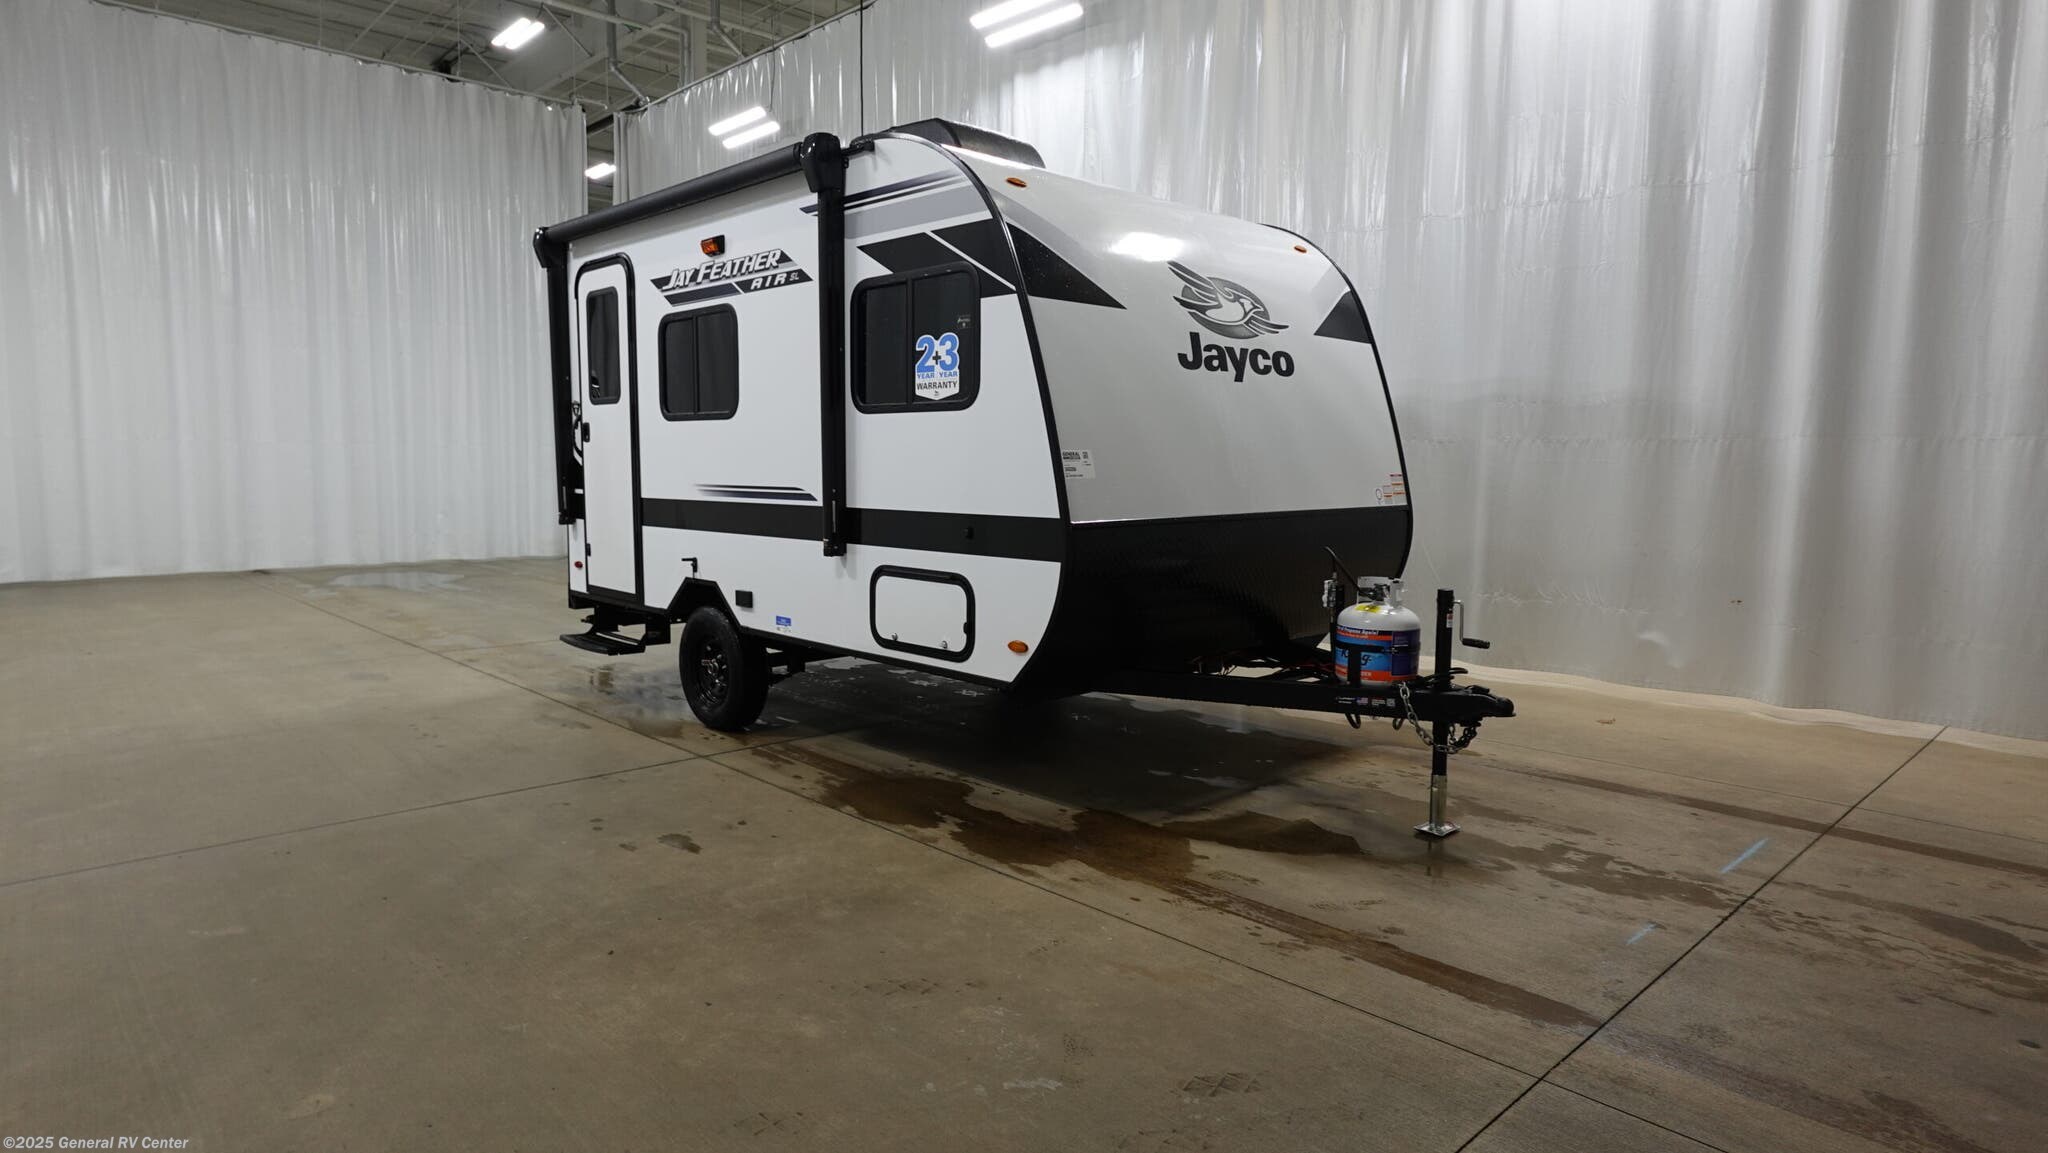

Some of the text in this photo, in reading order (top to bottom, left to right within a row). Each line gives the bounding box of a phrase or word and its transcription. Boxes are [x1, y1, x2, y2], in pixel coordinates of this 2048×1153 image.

[662, 249, 782, 291] JAY FEATHER
[750, 273, 788, 290] AIR
[1177, 331, 1295, 382] Jayco
[916, 380, 958, 391] WARRANTY
